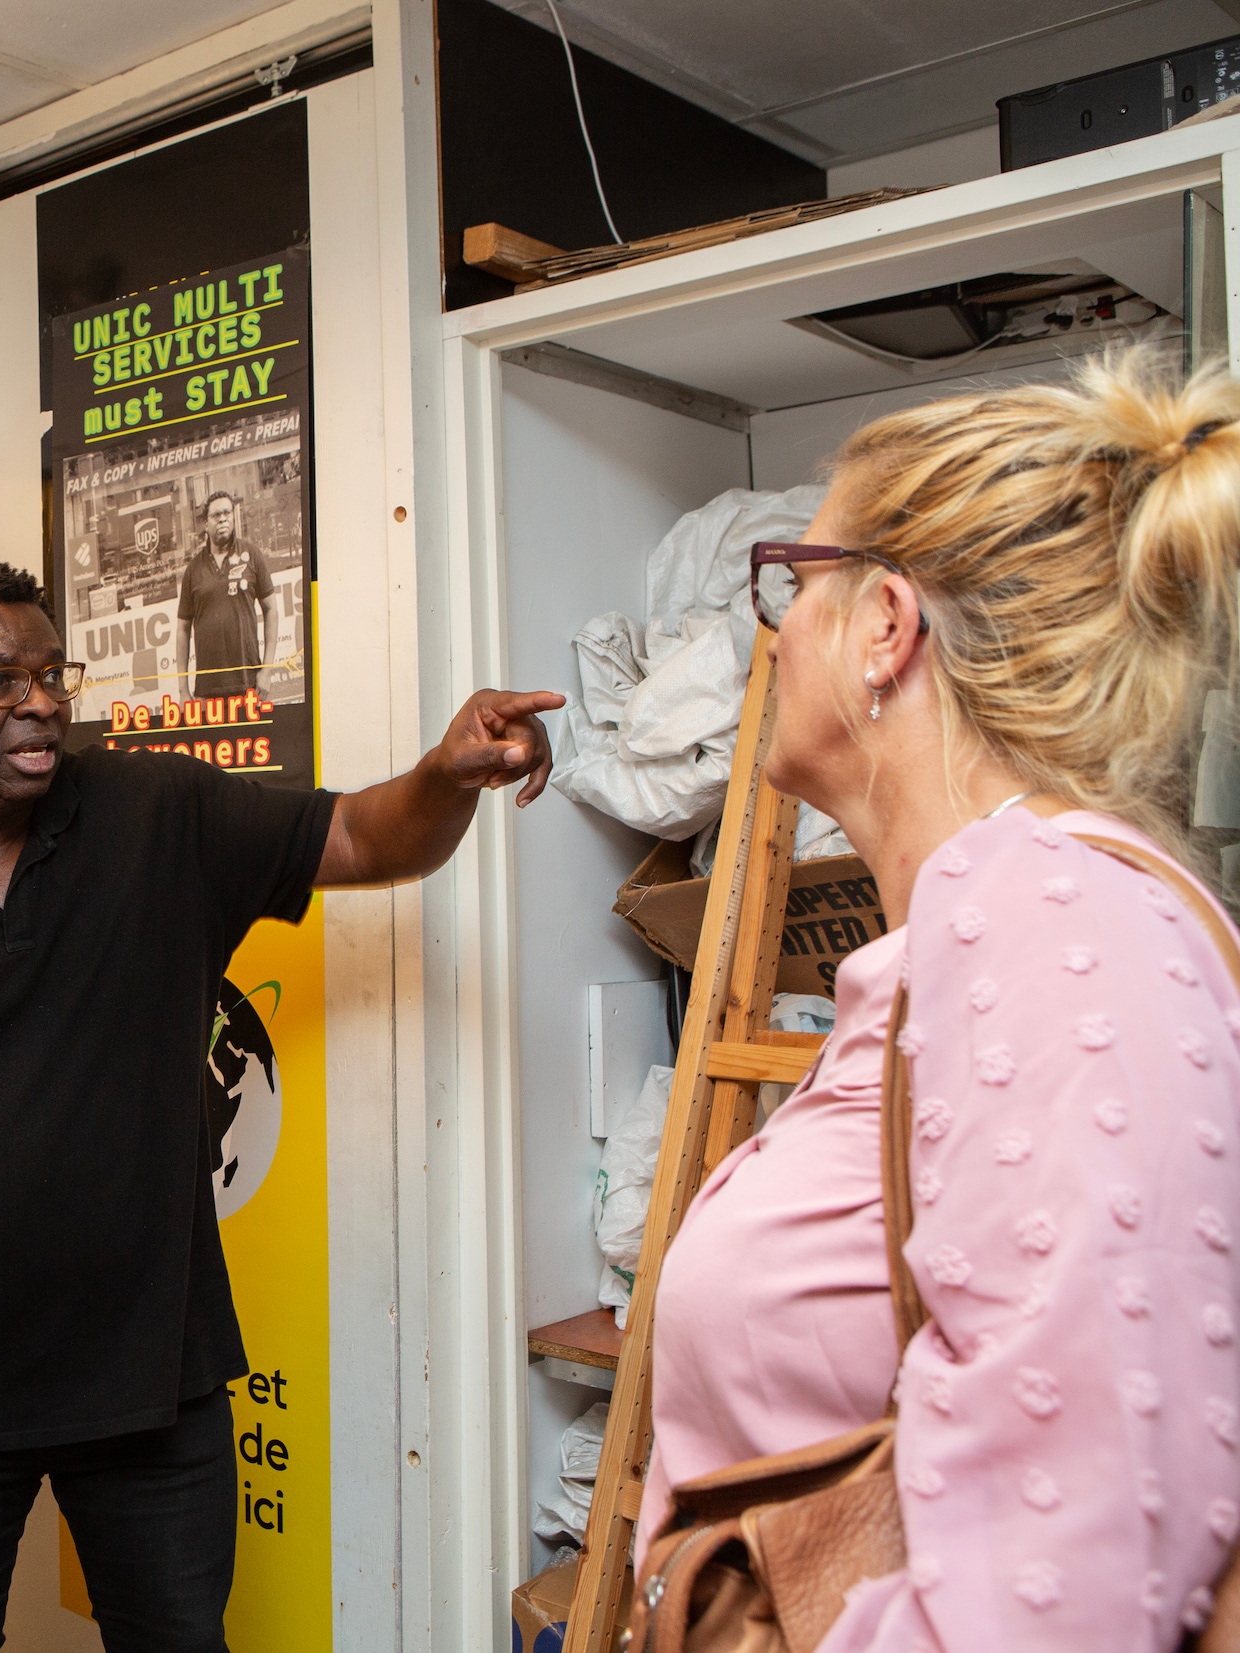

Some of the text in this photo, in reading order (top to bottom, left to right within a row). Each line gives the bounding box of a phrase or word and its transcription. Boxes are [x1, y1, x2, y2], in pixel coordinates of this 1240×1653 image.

[73, 263, 284, 354] UNIC MULTI
[92, 311, 262, 386] SERVICES
[83, 357, 276, 436] must STAY
[66, 475, 88, 495] FAX
[90, 473, 101, 488] &
[103, 461, 137, 484] COPY
[146, 441, 209, 472] INTERNET
[209, 431, 244, 454] CAFE
[86, 612, 172, 663] UNIC
[95, 670, 130, 683] Moneytrans
[112, 688, 274, 733] De buurt-
[780, 916, 870, 957] NITED
[247, 1369, 288, 1410] et
[239, 1422, 289, 1472] de
[244, 1480, 284, 1534] ici
